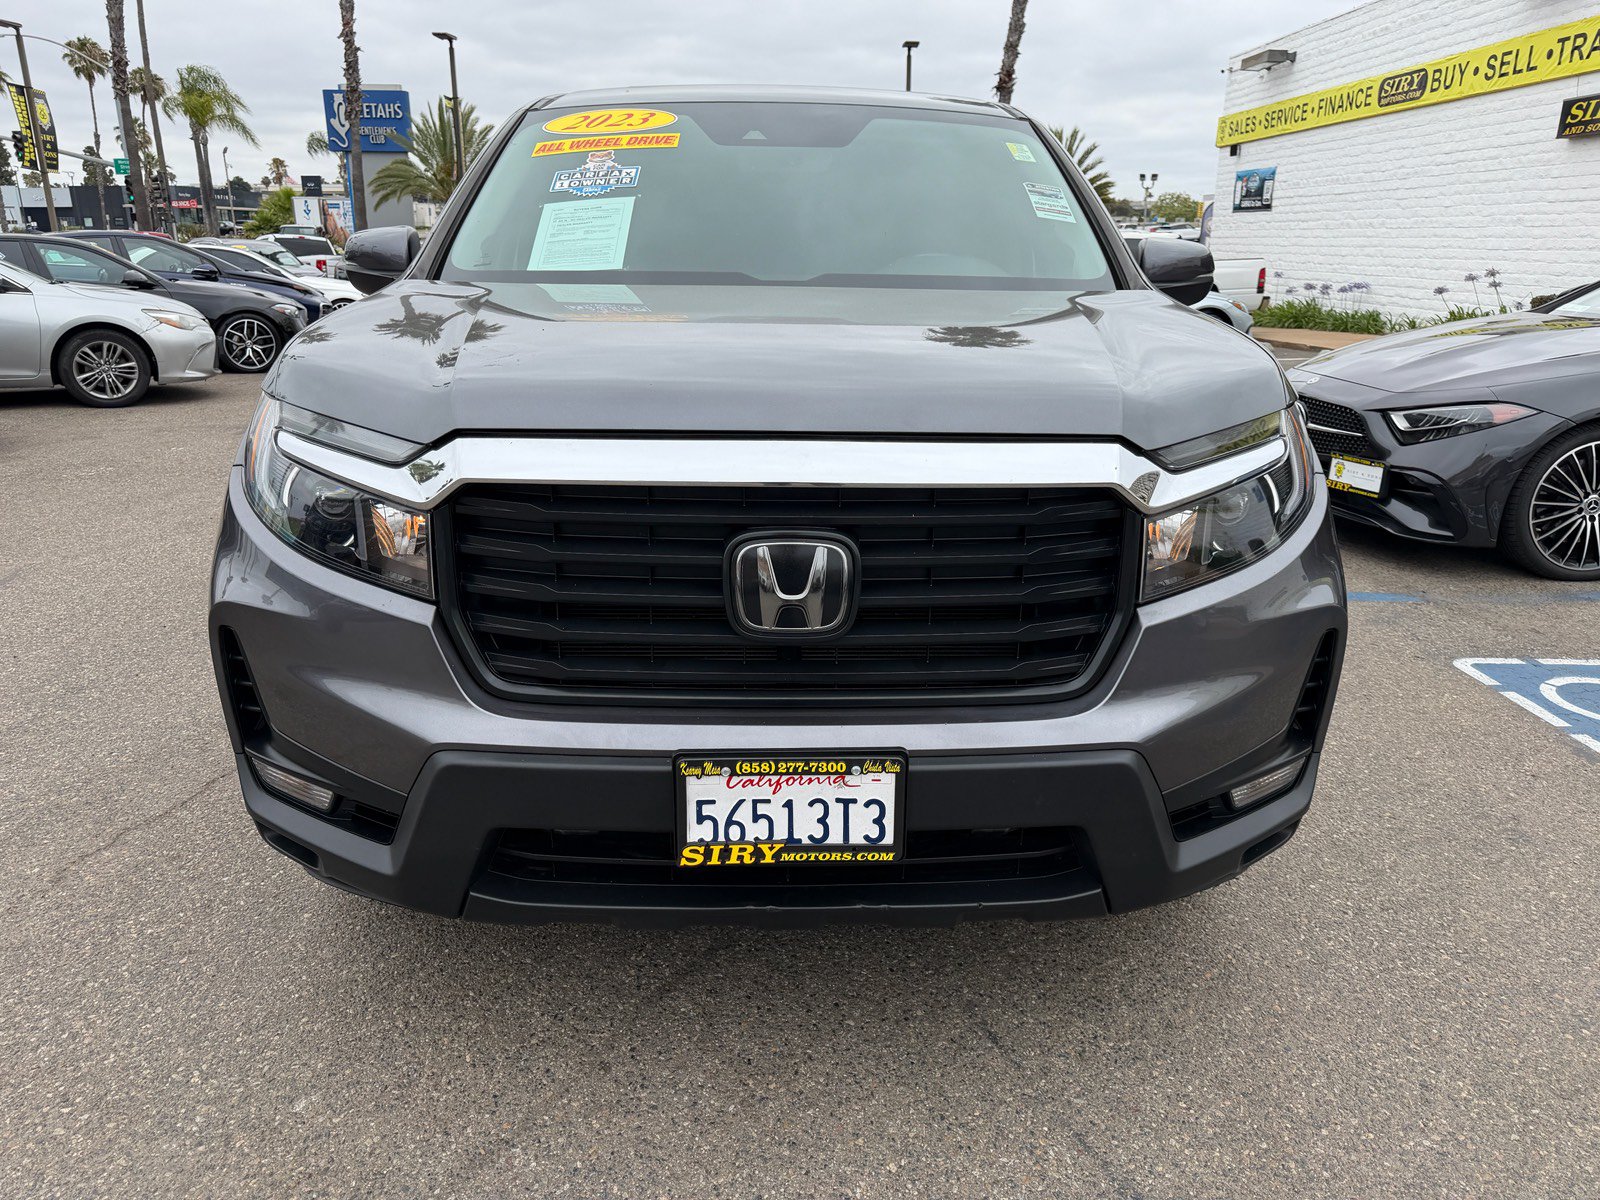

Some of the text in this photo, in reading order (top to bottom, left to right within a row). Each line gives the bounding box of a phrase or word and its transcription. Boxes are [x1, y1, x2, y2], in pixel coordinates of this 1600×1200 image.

[1228, 116, 1257, 137] SALES
[1264, 103, 1308, 129] SERVICE
[1317, 86, 1373, 117] FINANCE
[1430, 61, 1470, 92] BUY
[1484, 45, 1538, 81] SELL
[1381, 72, 1425, 97] SIRY
[8, 85, 27, 135] SERVICE
[18, 95, 29, 127] CARE
[360, 103, 403, 119] ETAHS
[1566, 100, 1600, 124] SI
[561, 113, 656, 130] 2023
[1562, 123, 1600, 136] AND SO
[369, 134, 386, 144] CLUB
[534, 135, 678, 155] ALL WHEEL DRIVE
[560, 170, 633, 180] CARFAX
[570, 177, 631, 187] OWNER
[1326, 479, 1351, 492] SIRY
[680, 762, 721, 779] Kearny Mesa
[735, 760, 846, 775] (858) 277-7300
[885, 761, 900, 773] Vista
[726, 775, 861, 795] California
[696, 798, 886, 845] 56513T3
[680, 843, 895, 866] SIRY MOTORS.COM
